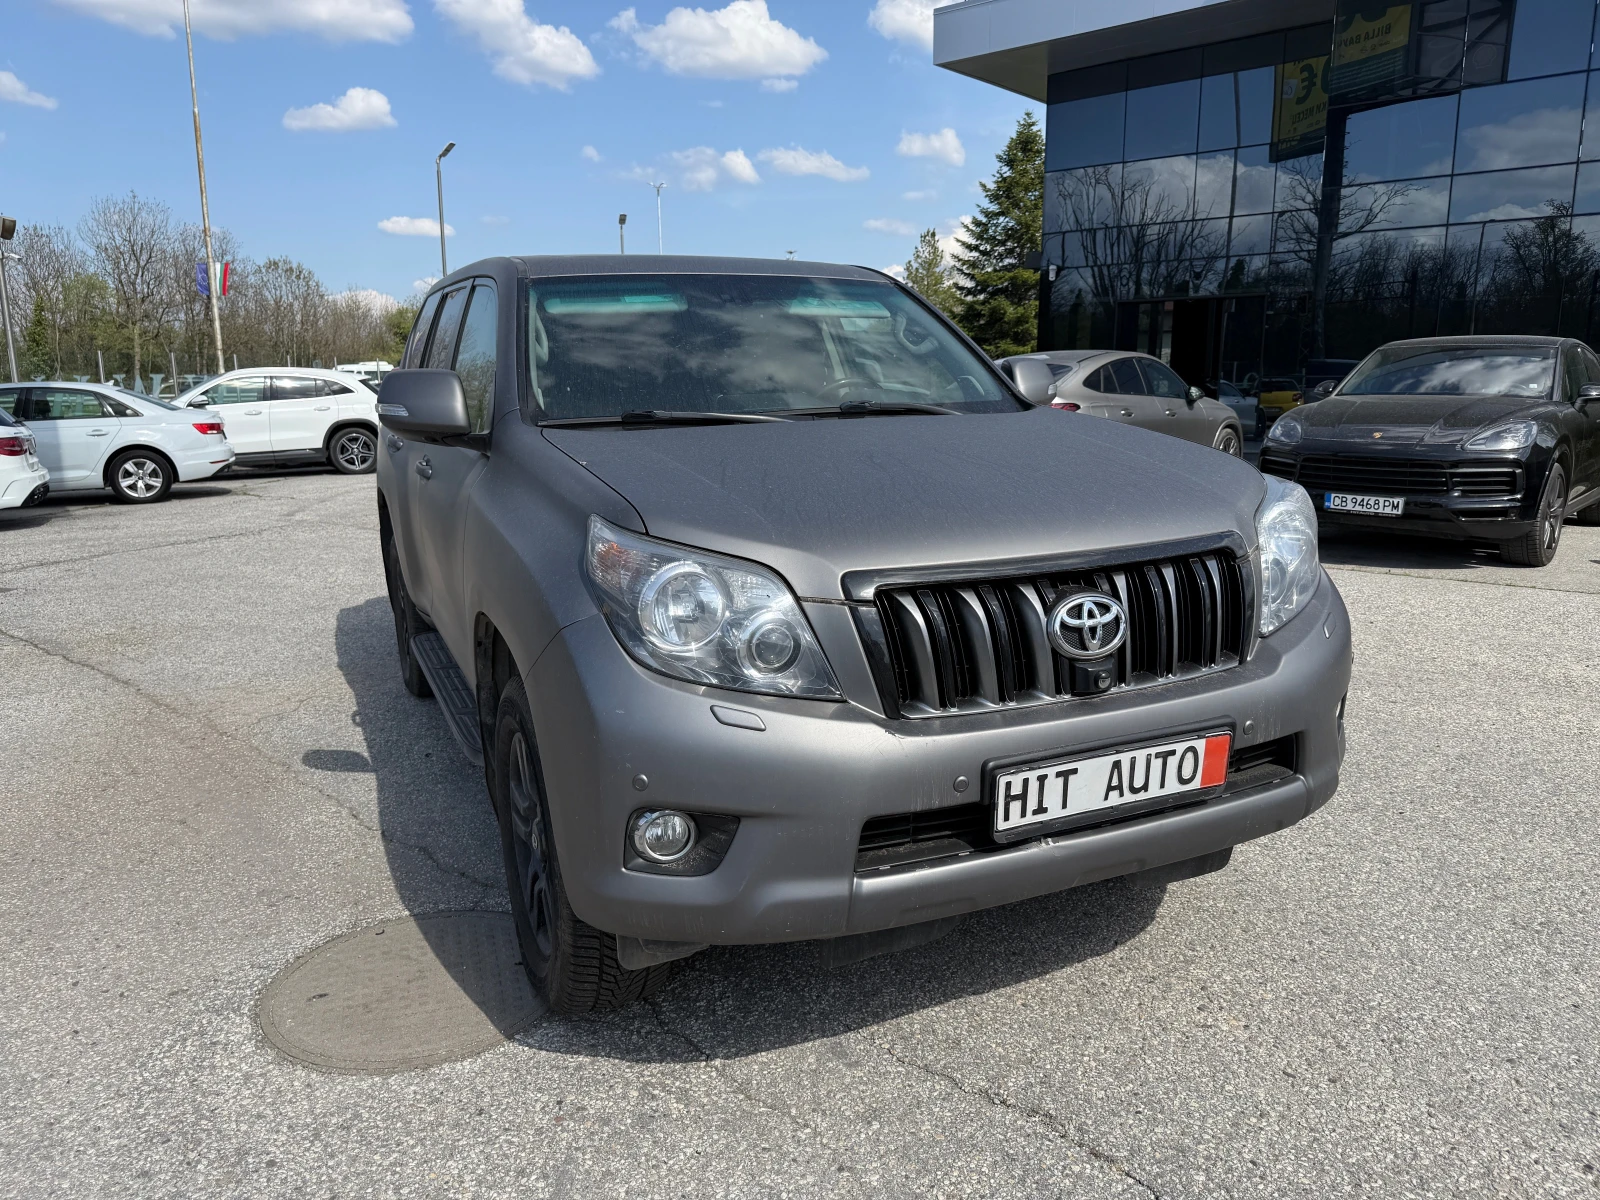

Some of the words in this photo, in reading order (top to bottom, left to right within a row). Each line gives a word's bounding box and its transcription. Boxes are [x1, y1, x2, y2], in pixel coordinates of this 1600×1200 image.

[1332, 495, 1348, 508] CB
[1351, 497, 1380, 511] 9468
[1382, 499, 1400, 512] PM
[1003, 767, 1078, 822] HIT
[1103, 745, 1199, 801] AUTO
